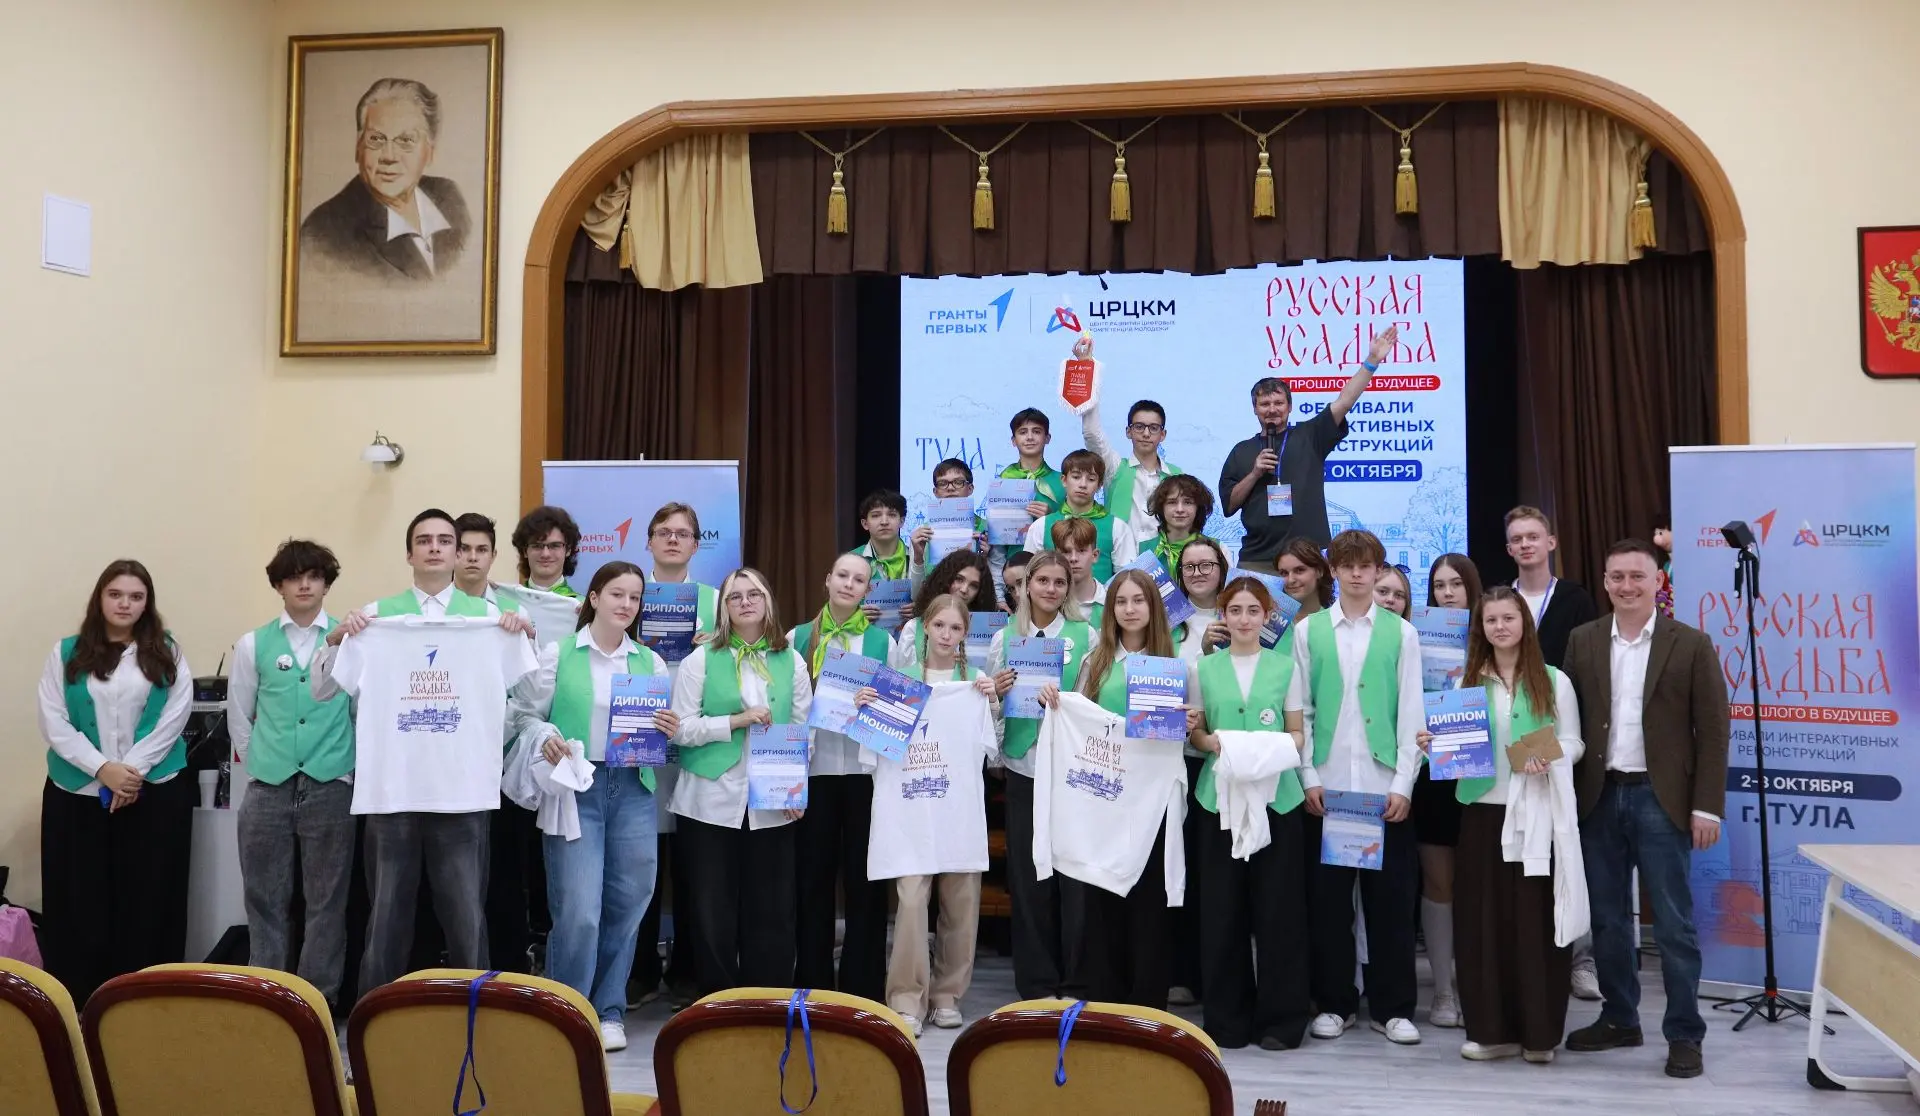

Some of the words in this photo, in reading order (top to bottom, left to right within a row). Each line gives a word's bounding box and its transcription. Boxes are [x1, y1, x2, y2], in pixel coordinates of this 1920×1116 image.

[1266, 274, 1423, 317] РУССКАЯ
[929, 310, 987, 321] ГРАНТЫ
[1089, 300, 1177, 319] ЦРЦКМ
[925, 324, 987, 335] ПЕРВЫХ
[1289, 379, 1348, 389] ПРОШЛО
[1375, 377, 1434, 389] БУДУЩЕЕ
[1336, 436, 1433, 454] СТРУКЦИЙ
[1331, 464, 1417, 478] ОКТЯБРЯ
[579, 534, 614, 542] АНТЫ
[1822, 524, 1890, 539] ЦРЦКМ
[581, 545, 614, 553] РВЫХ
[642, 603, 696, 613] ДИПЛОМ
[1699, 591, 1875, 640] РУССКАЯ
[1008, 660, 1062, 668] СЕРТИФИКАТ
[410, 670, 449, 682] РУССКАЯ
[1716, 645, 1892, 701] САДЬБА
[410, 683, 452, 695] УСАДЬБА
[1129, 675, 1184, 688] ДИПЛОМ
[613, 696, 667, 708] ДИПЛОМ
[1428, 709, 1487, 727] ДИПЛОМ
[1809, 707, 1820, 719] В
[1822, 708, 1892, 723] БУДУЩЕЕ
[858, 712, 910, 742] ДИПЛОМ
[1778, 732, 1900, 748] ИНТЕРАКТИВНЫХ
[1738, 744, 1856, 762] РЕОНСТРУКЦИЙ
[1773, 776, 1855, 794] ОКТЯБРЯ
[1767, 802, 1855, 830] ТУЛА
